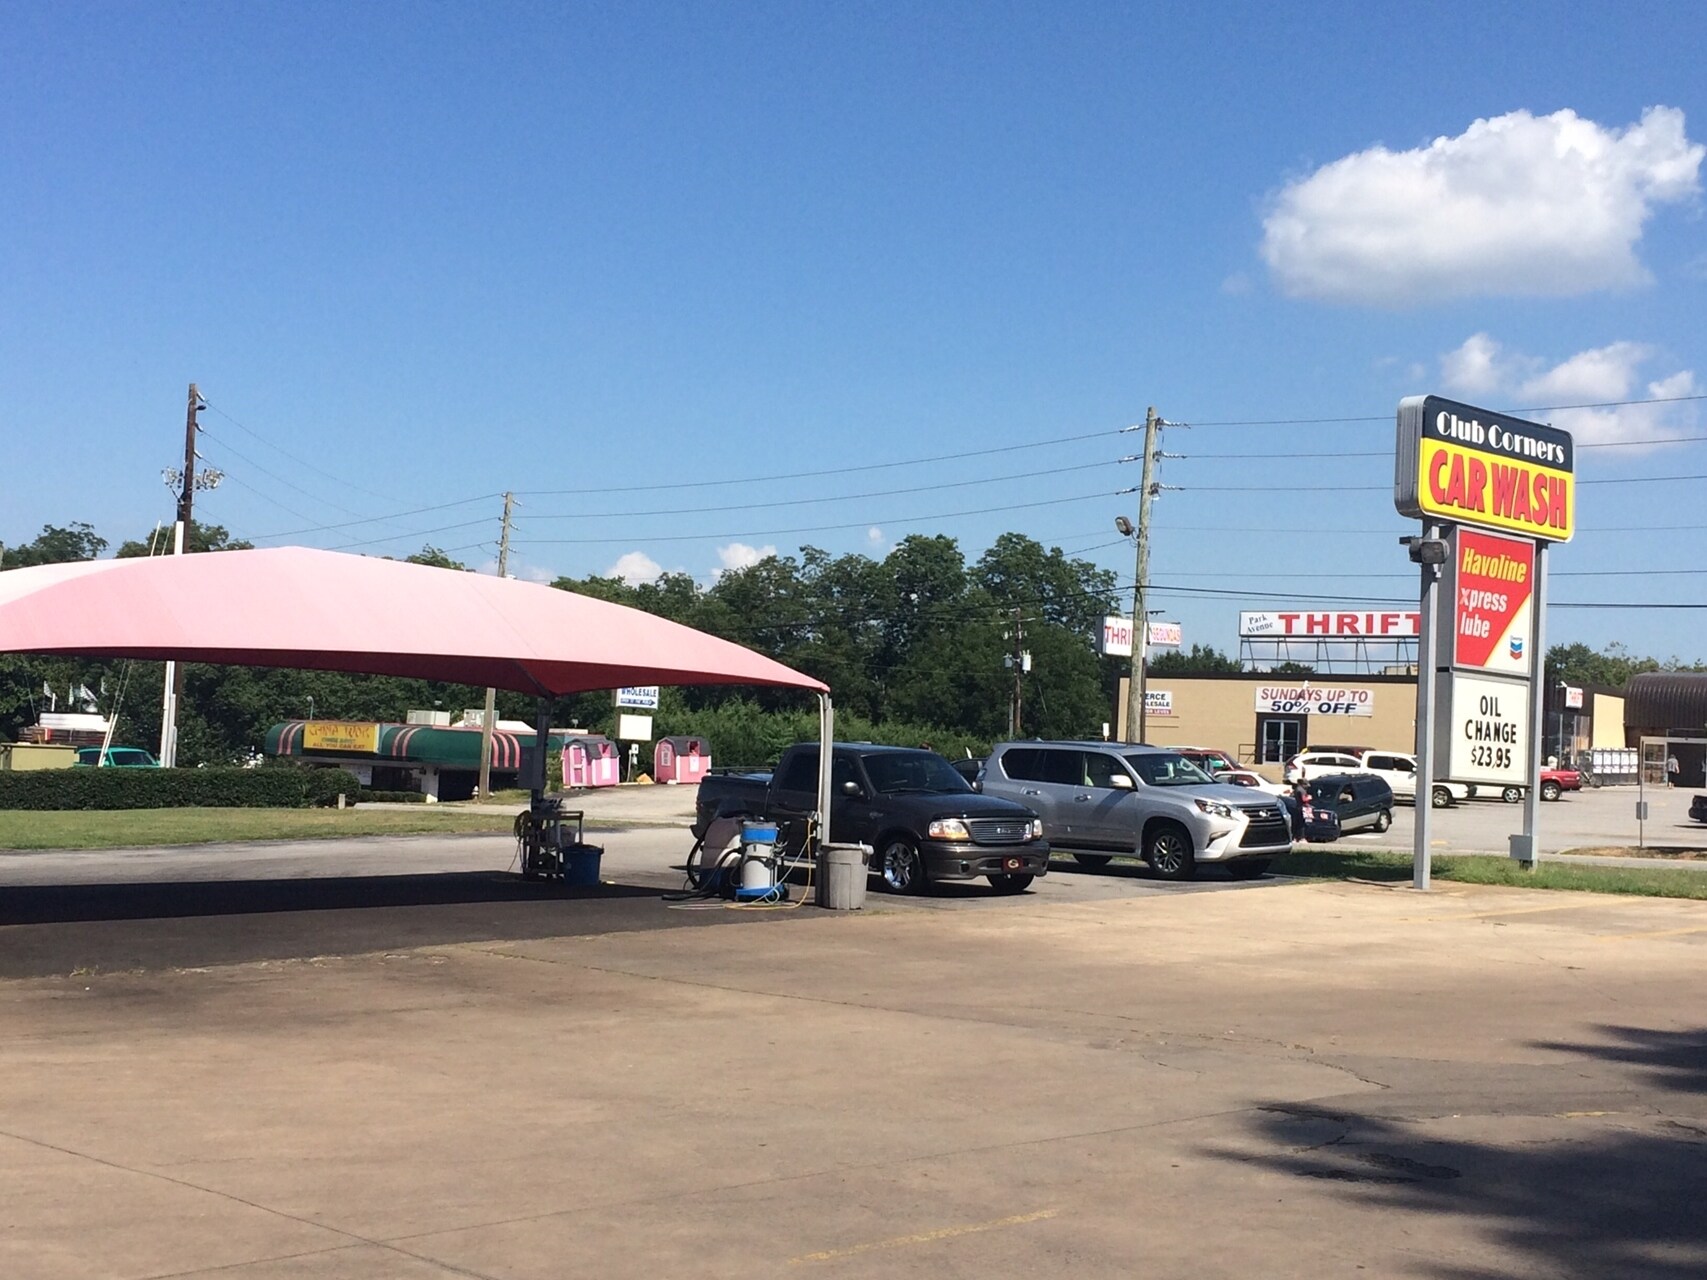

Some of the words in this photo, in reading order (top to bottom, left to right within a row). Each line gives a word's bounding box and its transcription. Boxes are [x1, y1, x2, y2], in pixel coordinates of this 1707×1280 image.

[1436, 411, 1485, 445] Club
[1488, 425, 1565, 464] Corners
[1429, 449, 1488, 513] CAR
[1491, 462, 1567, 531] WASH
[1461, 547, 1527, 583] Havoline
[1459, 587, 1508, 613] xpress
[1247, 621, 1274, 633] Avenue
[1248, 614, 1268, 625] Park
[1278, 614, 1420, 634] THRIFT
[1460, 611, 1490, 638] lube
[621, 688, 657, 697] WHOLESALE
[1261, 688, 1322, 701] SUNDAYS
[1327, 690, 1346, 702] UP
[1351, 690, 1368, 703] TO
[1271, 701, 1310, 713] 50%
[1318, 702, 1357, 713] OFF
[1480, 695, 1501, 717] OIL
[1465, 719, 1517, 744] CHANGE
